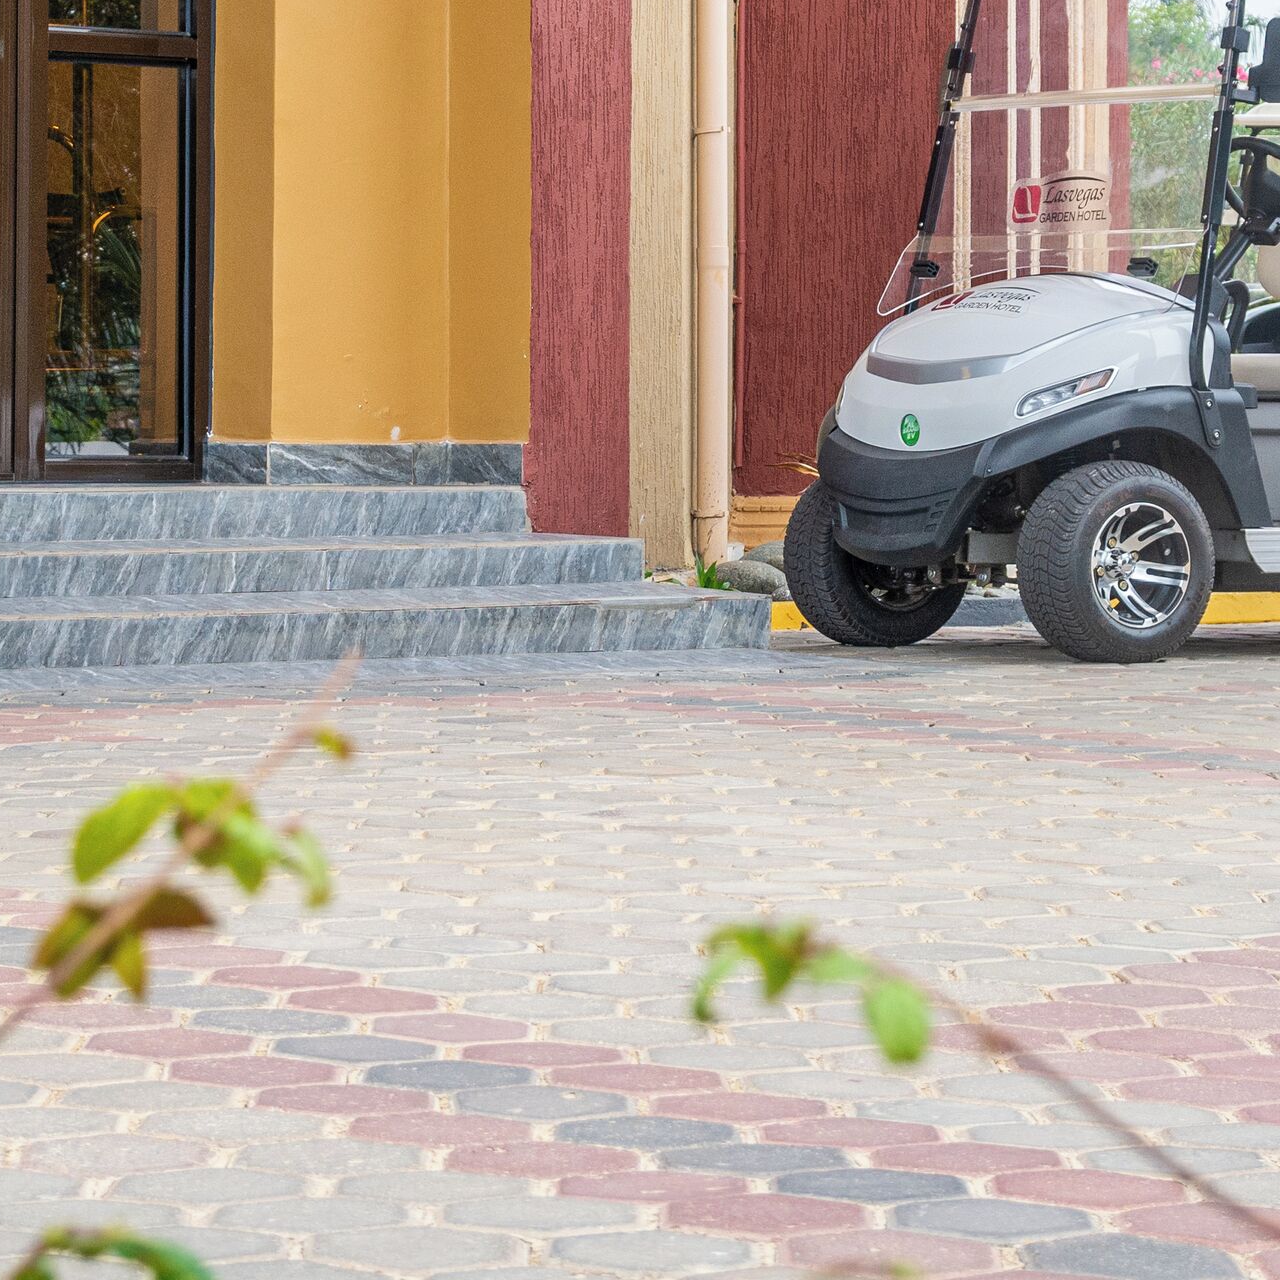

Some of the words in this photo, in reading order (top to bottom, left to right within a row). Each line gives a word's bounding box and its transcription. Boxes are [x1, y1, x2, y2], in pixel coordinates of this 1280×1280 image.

[1042, 186, 1106, 210] Lasvegas
[1039, 211, 1075, 224] GARDEN
[1077, 209, 1107, 221] HOTEL
[954, 302, 992, 310] GARDEN
[992, 302, 1022, 314] HOTEL
